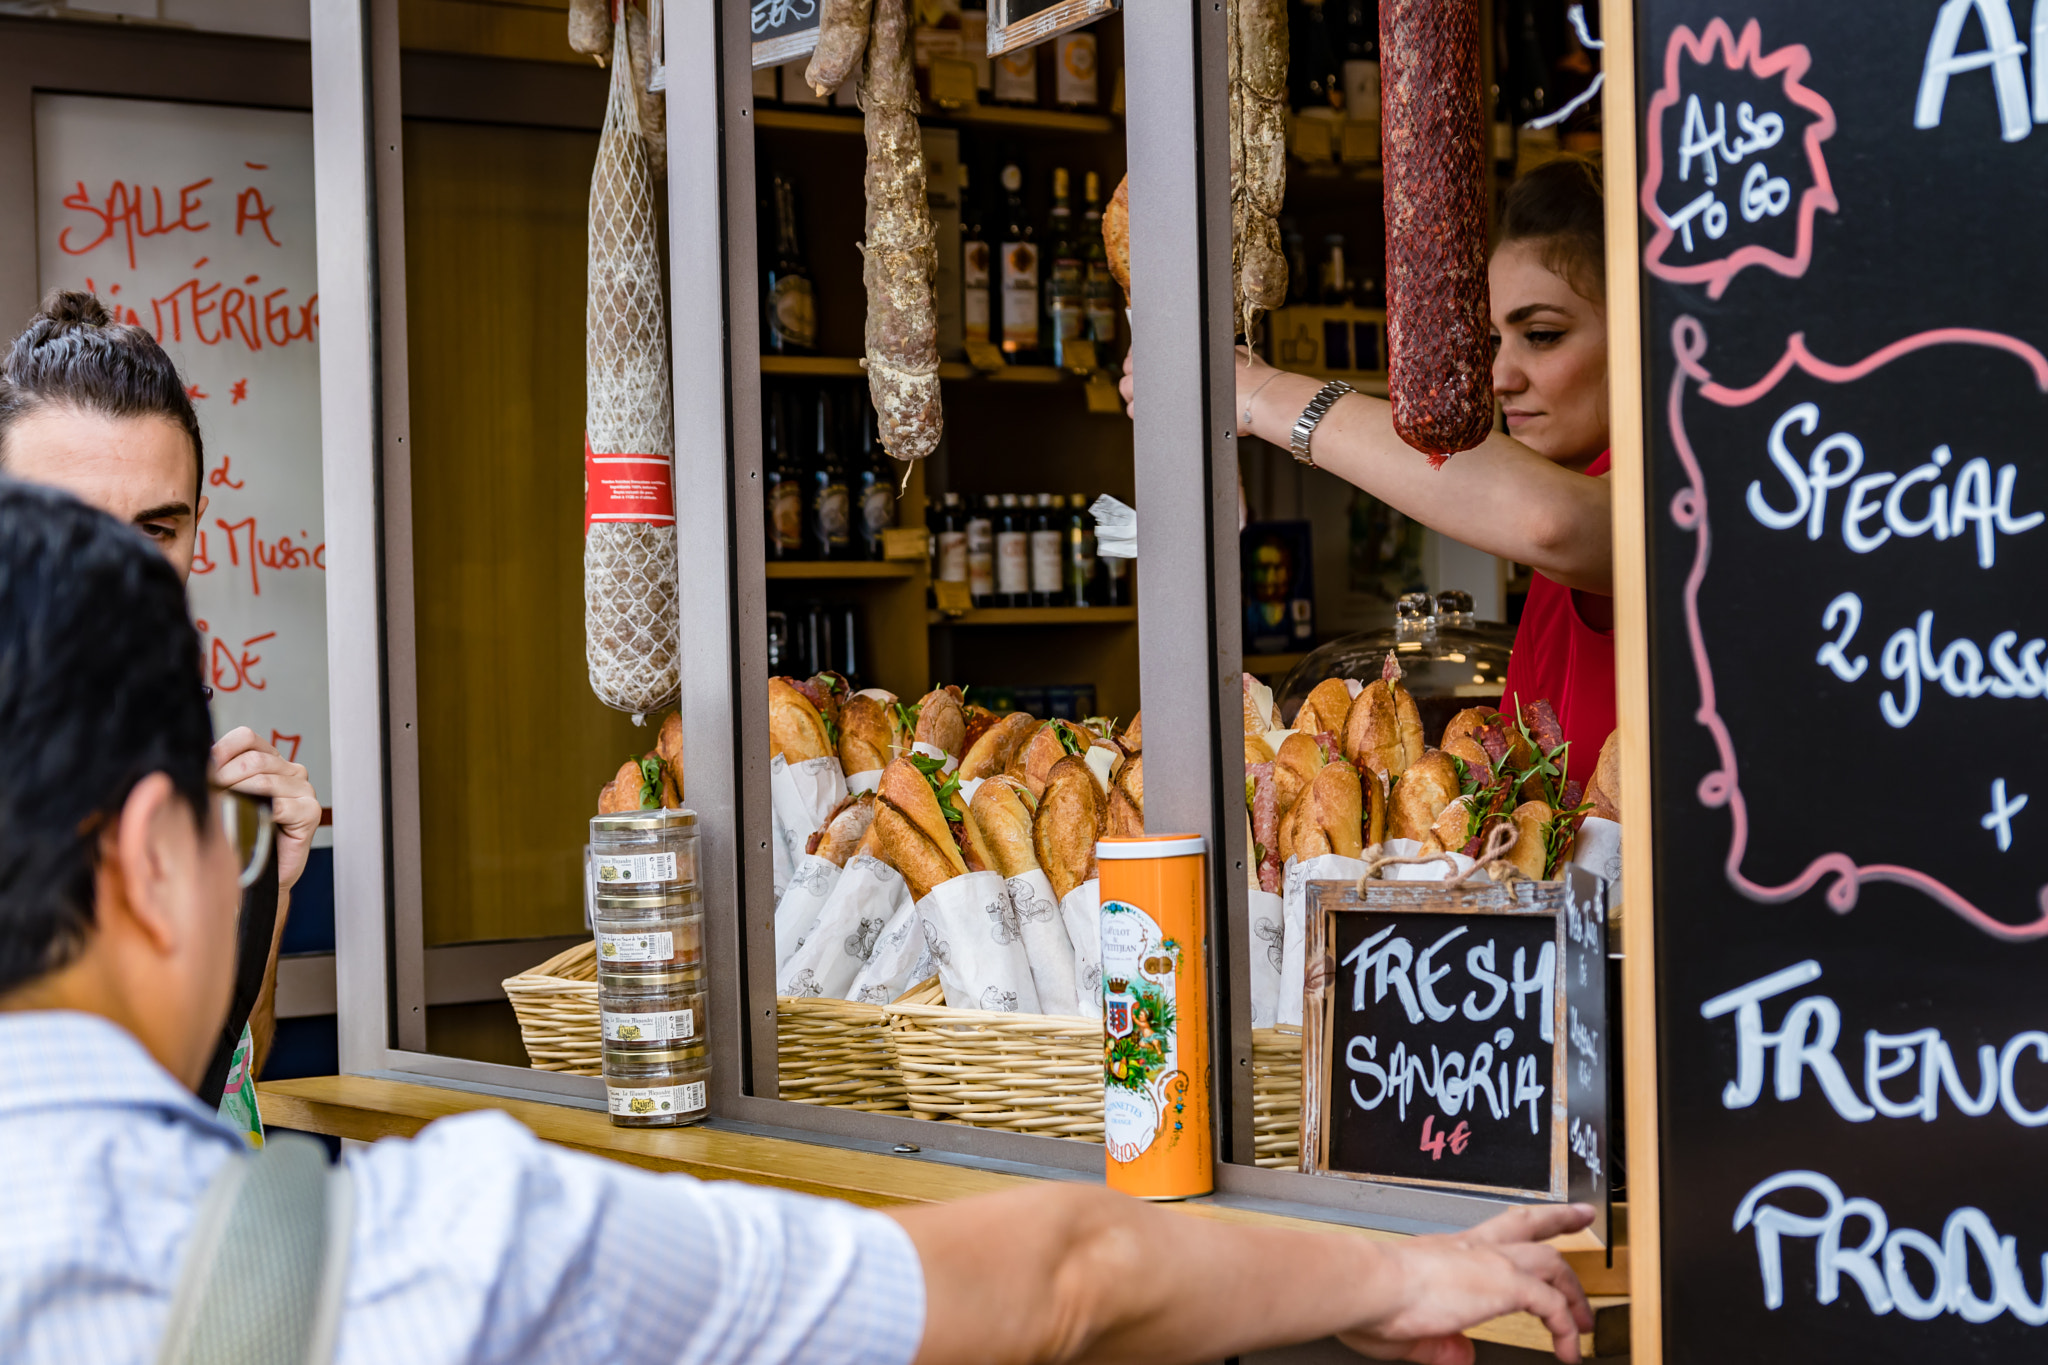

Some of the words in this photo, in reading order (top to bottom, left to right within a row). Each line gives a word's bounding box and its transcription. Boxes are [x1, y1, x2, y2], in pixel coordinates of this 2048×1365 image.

[58, 178, 213, 270] SALLE
[1665, 190, 1728, 252] TO
[1740, 161, 1790, 222] GO
[1815, 592, 1869, 683] 2
[1879, 609, 2048, 729] glass
[1341, 924, 1556, 1044] FRESH
[1700, 958, 2048, 1128] FRENC
[1419, 1115, 1472, 1161] 4€
[1733, 1169, 2048, 1326] PRODU
